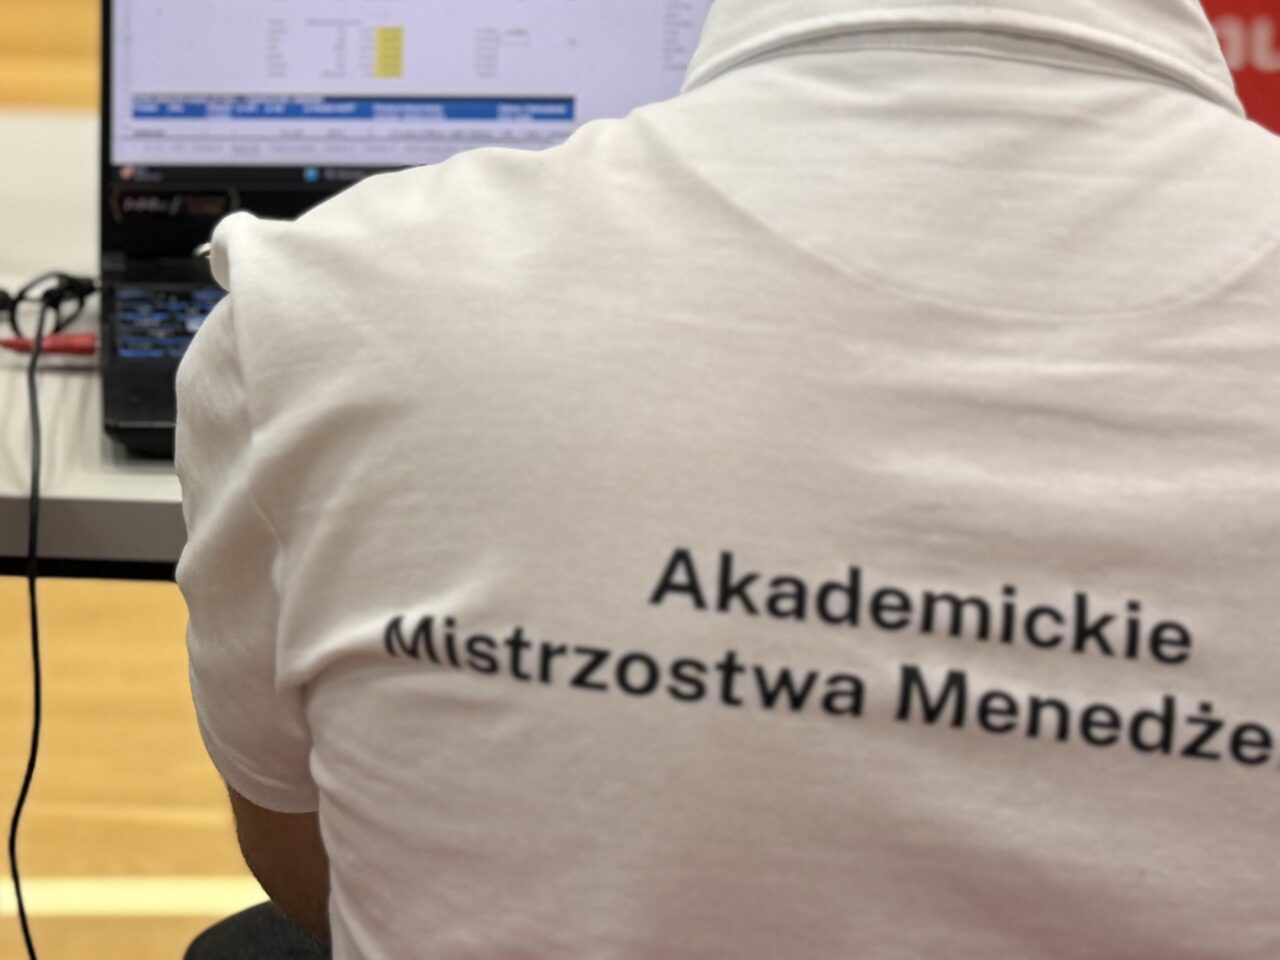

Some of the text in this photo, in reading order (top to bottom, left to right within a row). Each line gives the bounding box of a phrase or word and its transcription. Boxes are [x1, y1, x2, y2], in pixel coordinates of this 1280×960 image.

[649, 548, 1192, 667] Akademickie
[383, 615, 1280, 768] Mistrzostwa Menedże
